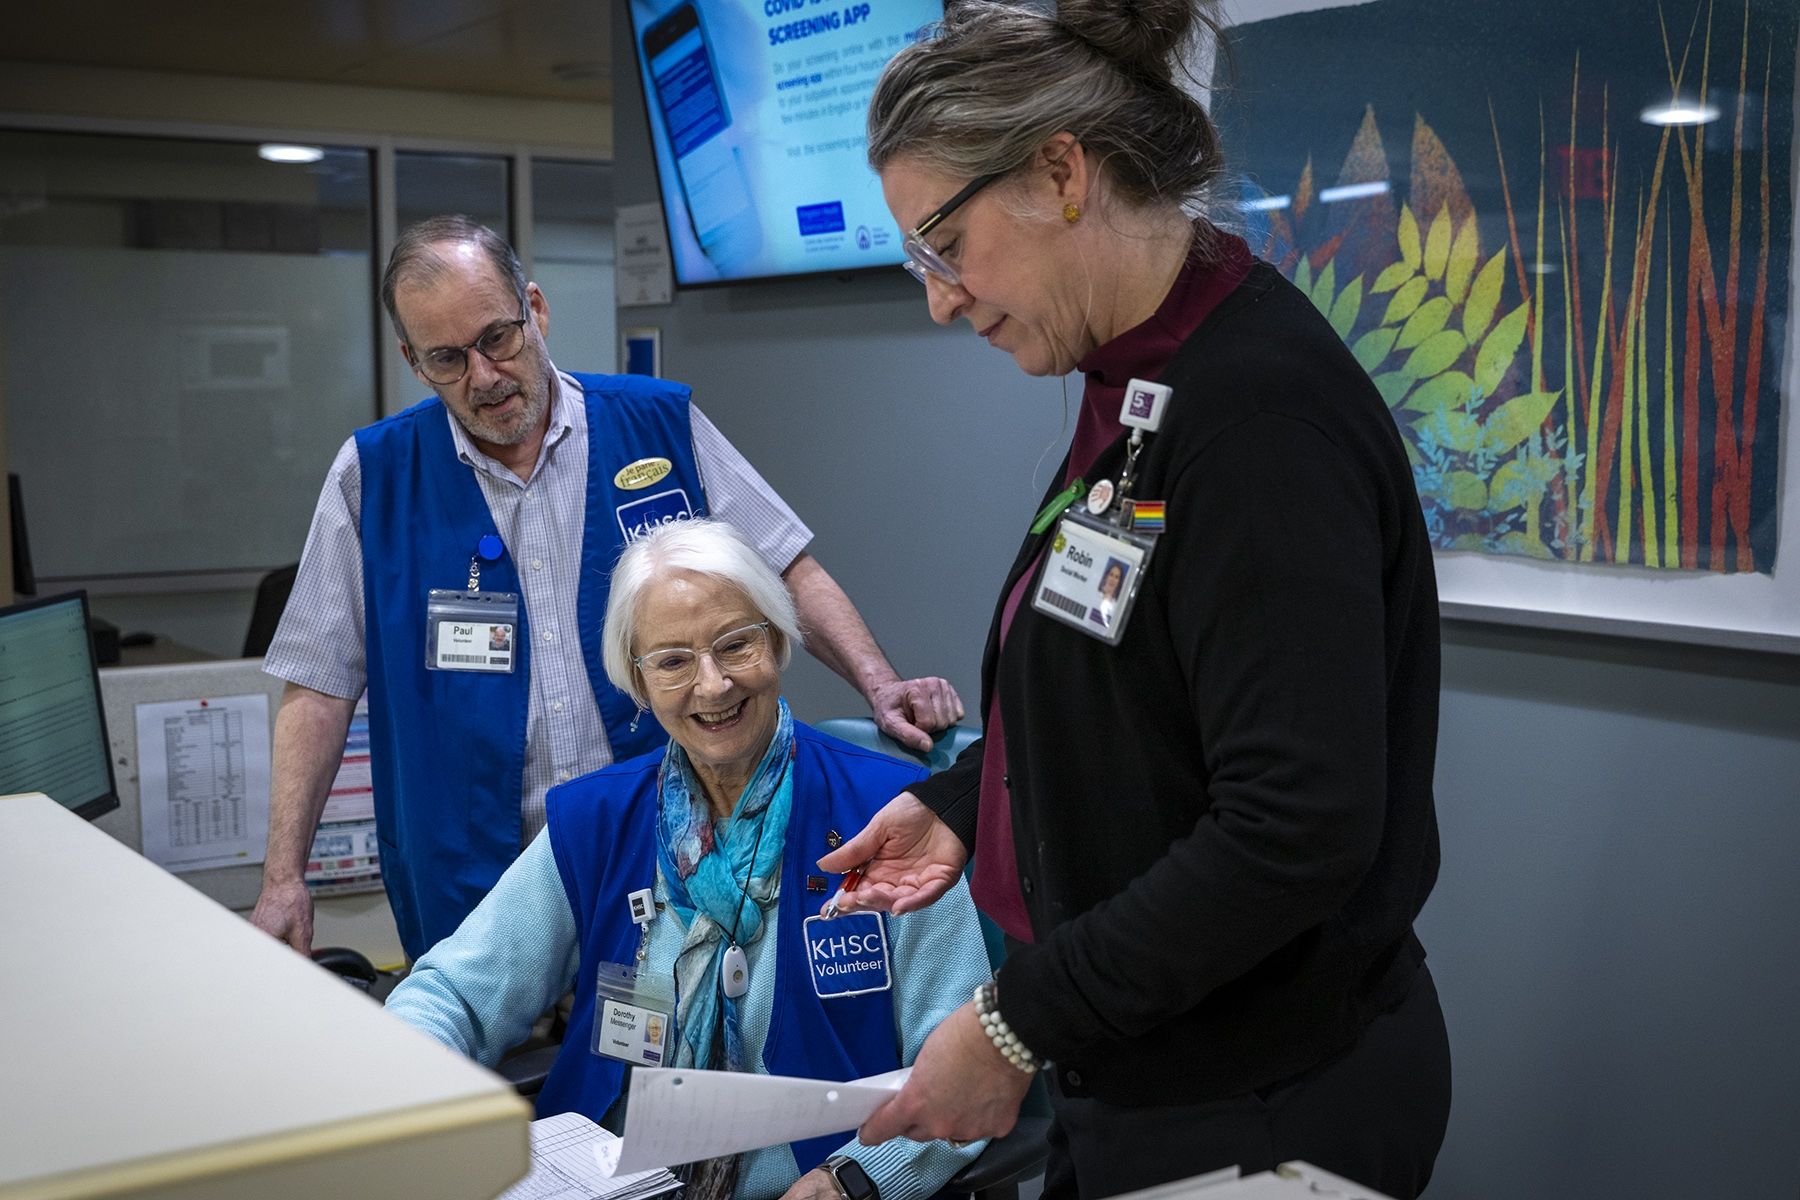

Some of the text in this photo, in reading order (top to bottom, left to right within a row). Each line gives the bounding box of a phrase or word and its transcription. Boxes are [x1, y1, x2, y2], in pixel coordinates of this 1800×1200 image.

[764, 0, 804, 17] COVID
[768, 3, 871, 46] SCREENING APP
[1133, 391, 1144, 409] 5
[620, 463, 669, 488] français
[1066, 545, 1093, 568] Robin
[453, 626, 473, 635] Paul
[811, 934, 880, 960] KHSC
[815, 960, 883, 977] Volunteer
[613, 1007, 636, 1022] Dorothy
[610, 1016, 637, 1031] Messenger
